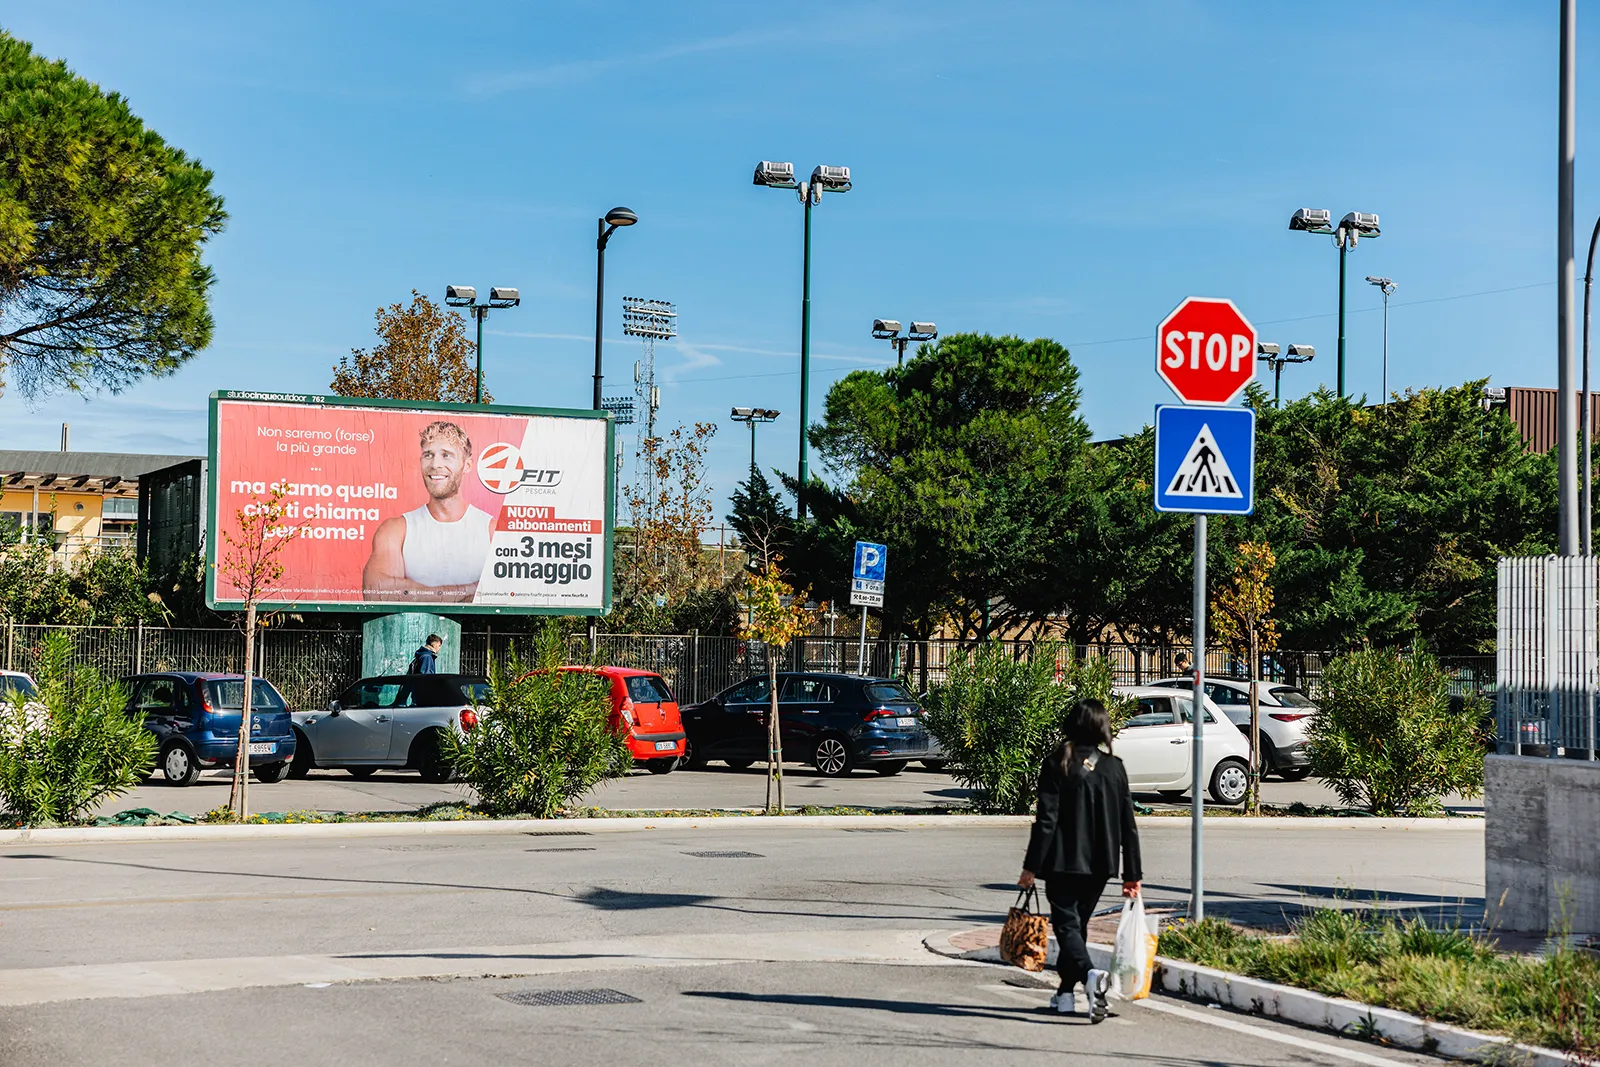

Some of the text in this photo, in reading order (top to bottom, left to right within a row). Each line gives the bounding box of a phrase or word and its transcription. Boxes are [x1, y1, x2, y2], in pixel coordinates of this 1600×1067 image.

[1164, 330, 1251, 373] STOP
[227, 390, 325, 404] studiocinqueoutdoor 762
[257, 426, 375, 444] Non saremo (forse)
[276, 441, 357, 457] la più grande
[230, 478, 398, 503] ma siamo quella
[525, 487, 557, 496] PESCARA
[286, 501, 300, 520] ti
[302, 503, 380, 521] chiama
[507, 506, 549, 519] NUOVI
[263, 524, 366, 541] per nome!
[507, 518, 592, 533] abbonamenti
[495, 536, 592, 560] con 3 mesi
[860, 546, 880, 575] P
[493, 557, 592, 585] omaggio
